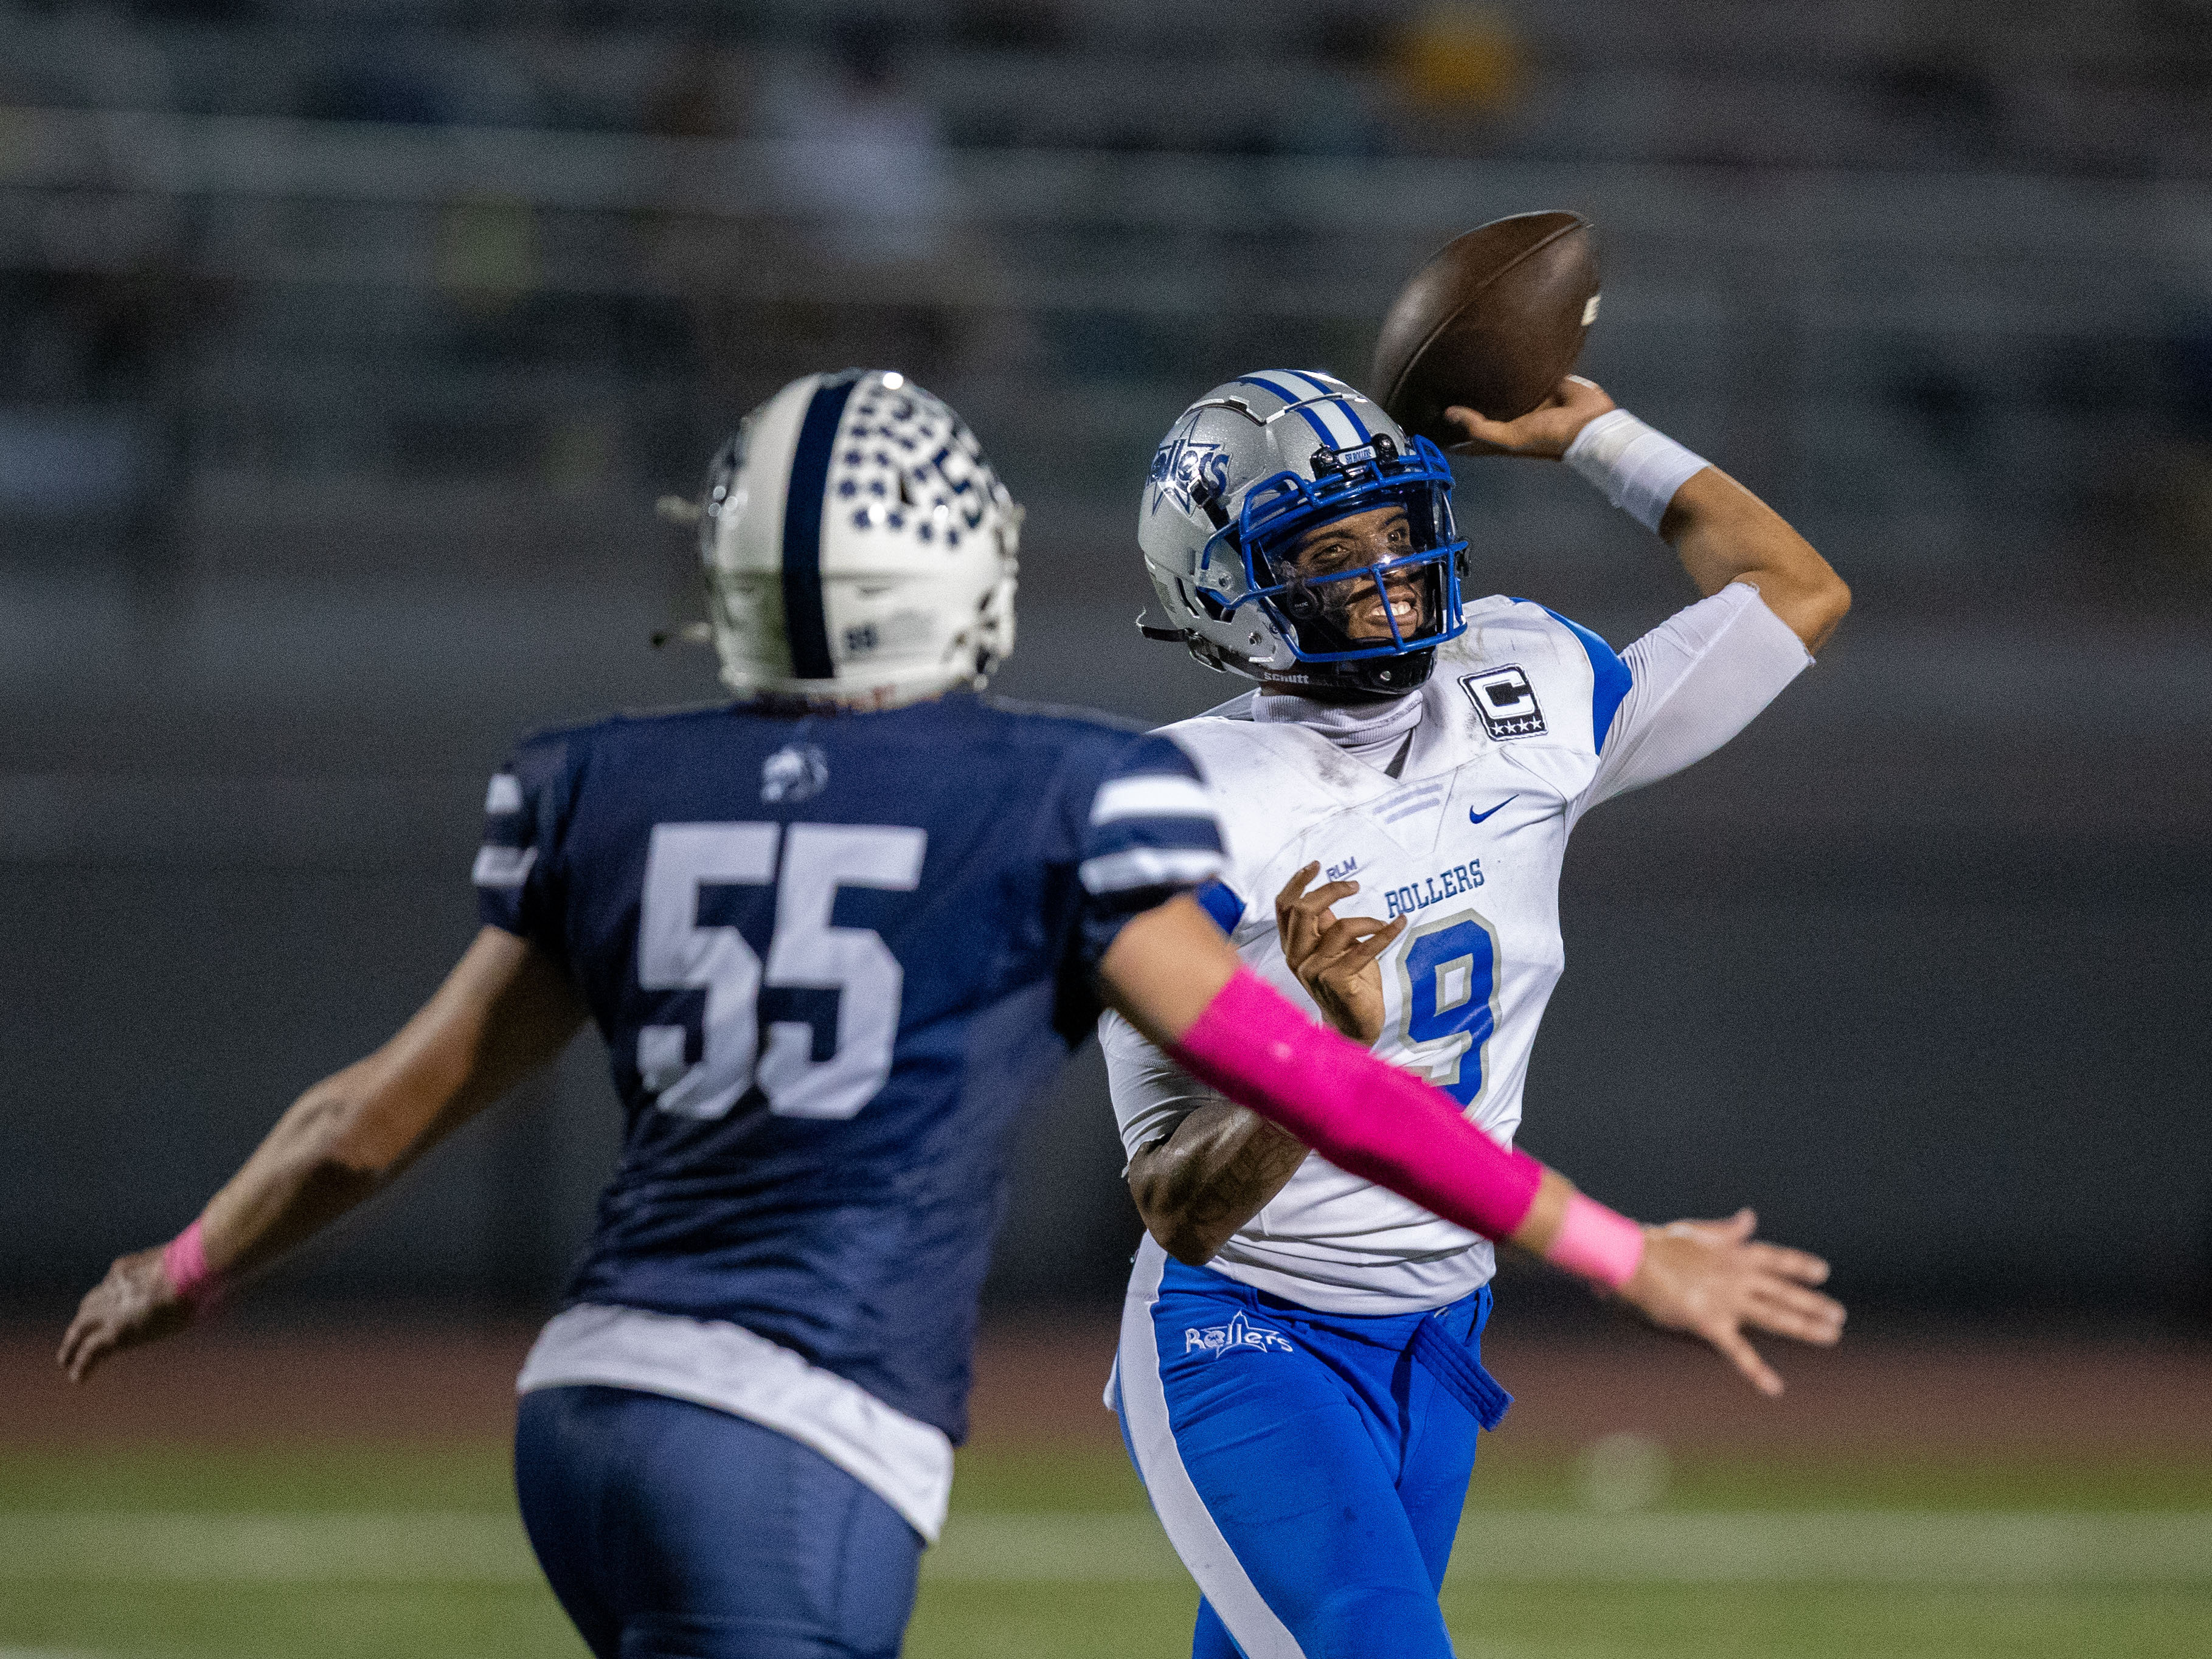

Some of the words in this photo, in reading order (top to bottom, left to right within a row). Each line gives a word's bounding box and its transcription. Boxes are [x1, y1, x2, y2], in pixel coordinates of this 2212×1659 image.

[1146, 439, 1230, 499] ollers
[1469, 670, 1535, 719] C
[1326, 856, 1357, 882] RLM
[1384, 858, 1485, 919] ROLLERS
[636, 821, 927, 1121] 55
[1396, 907, 1502, 1120] 9
[1184, 1322, 1294, 1353] Rollers
